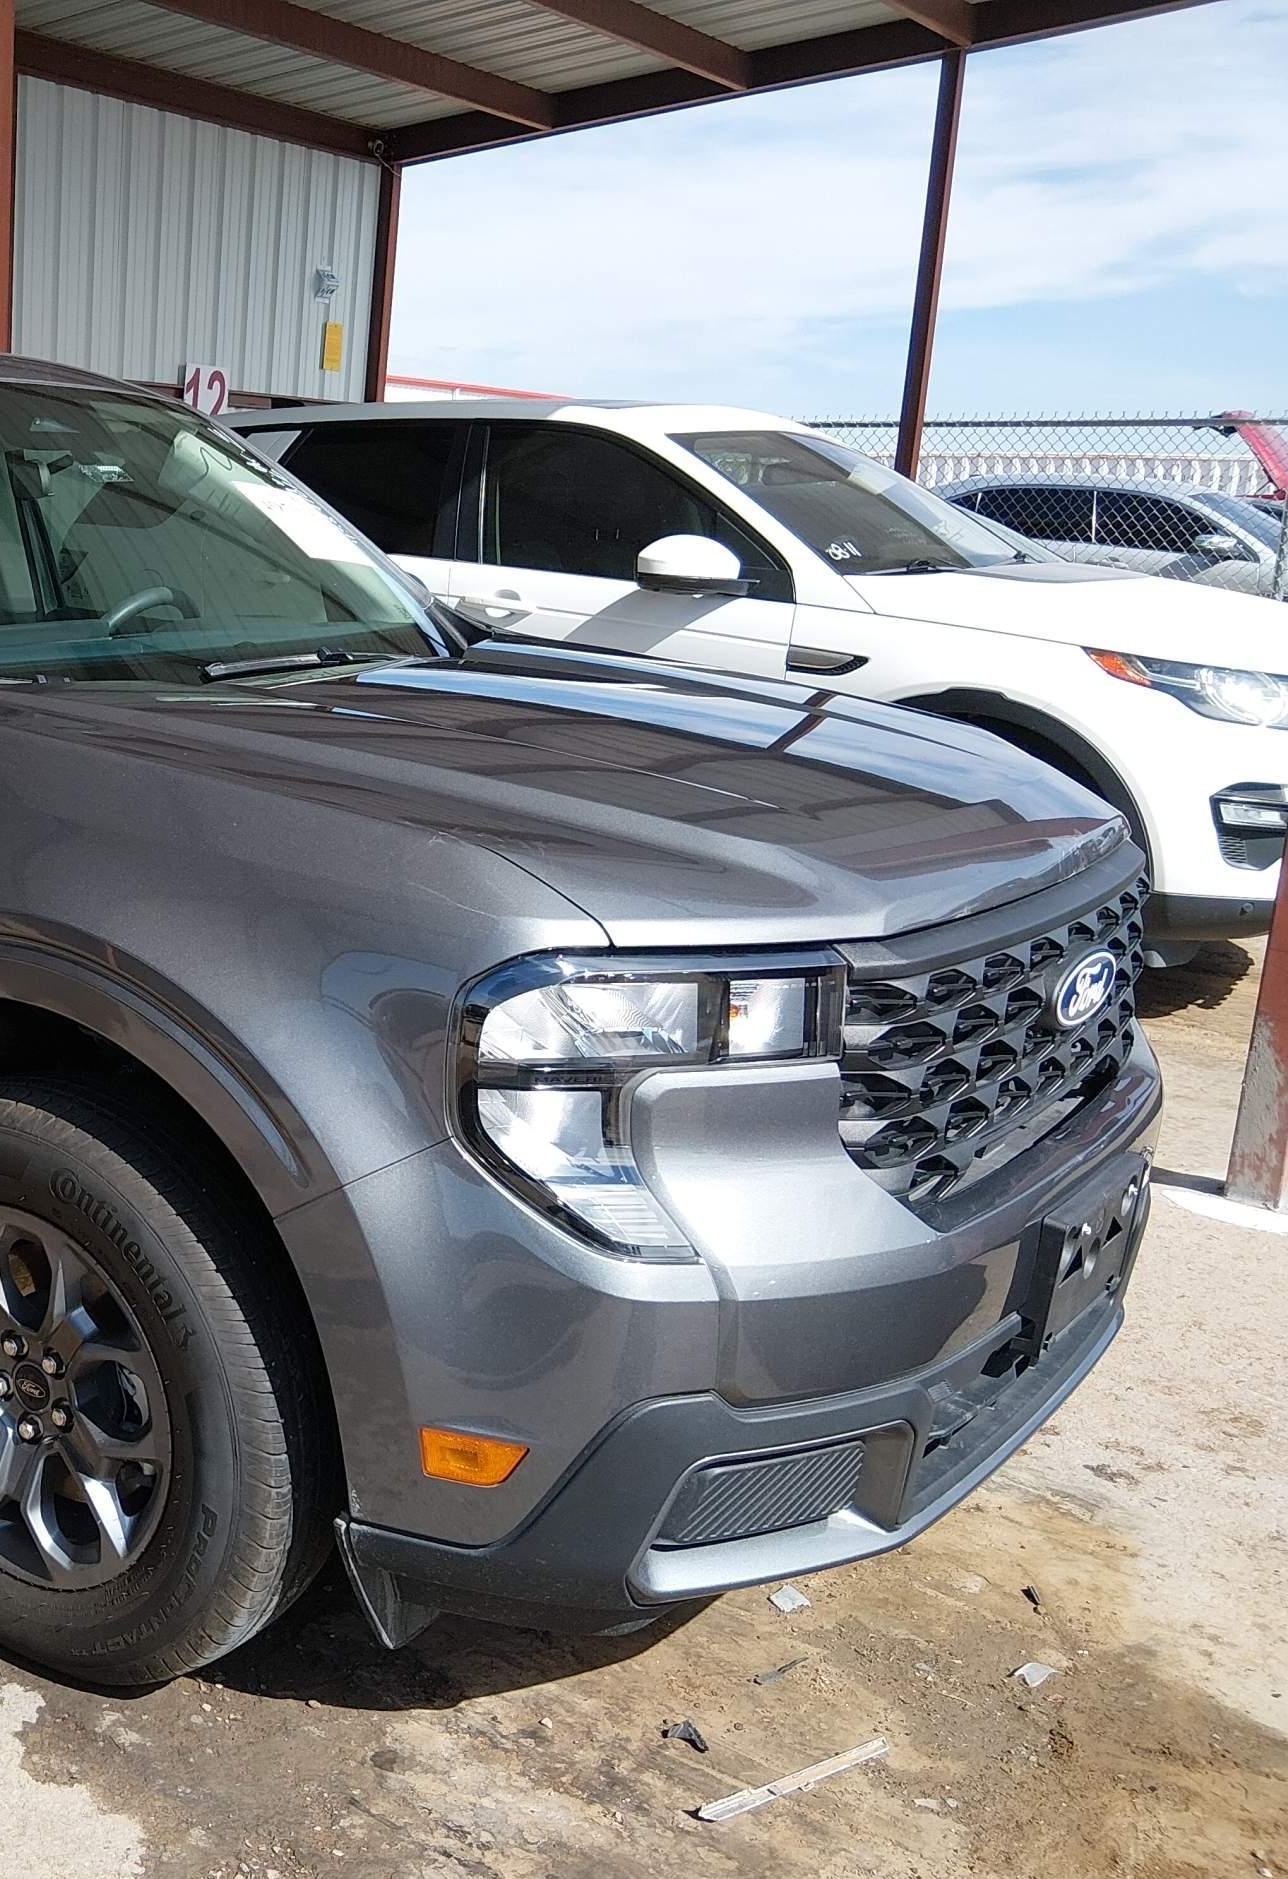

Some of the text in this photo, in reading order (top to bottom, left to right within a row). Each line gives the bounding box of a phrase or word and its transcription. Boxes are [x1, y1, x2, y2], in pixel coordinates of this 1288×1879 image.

[185, 367, 225, 417] 12
[1067, 961, 1110, 1018] Ford
[48, 1167, 187, 1324] Continental
[20, 1380, 41, 1397] Ford
